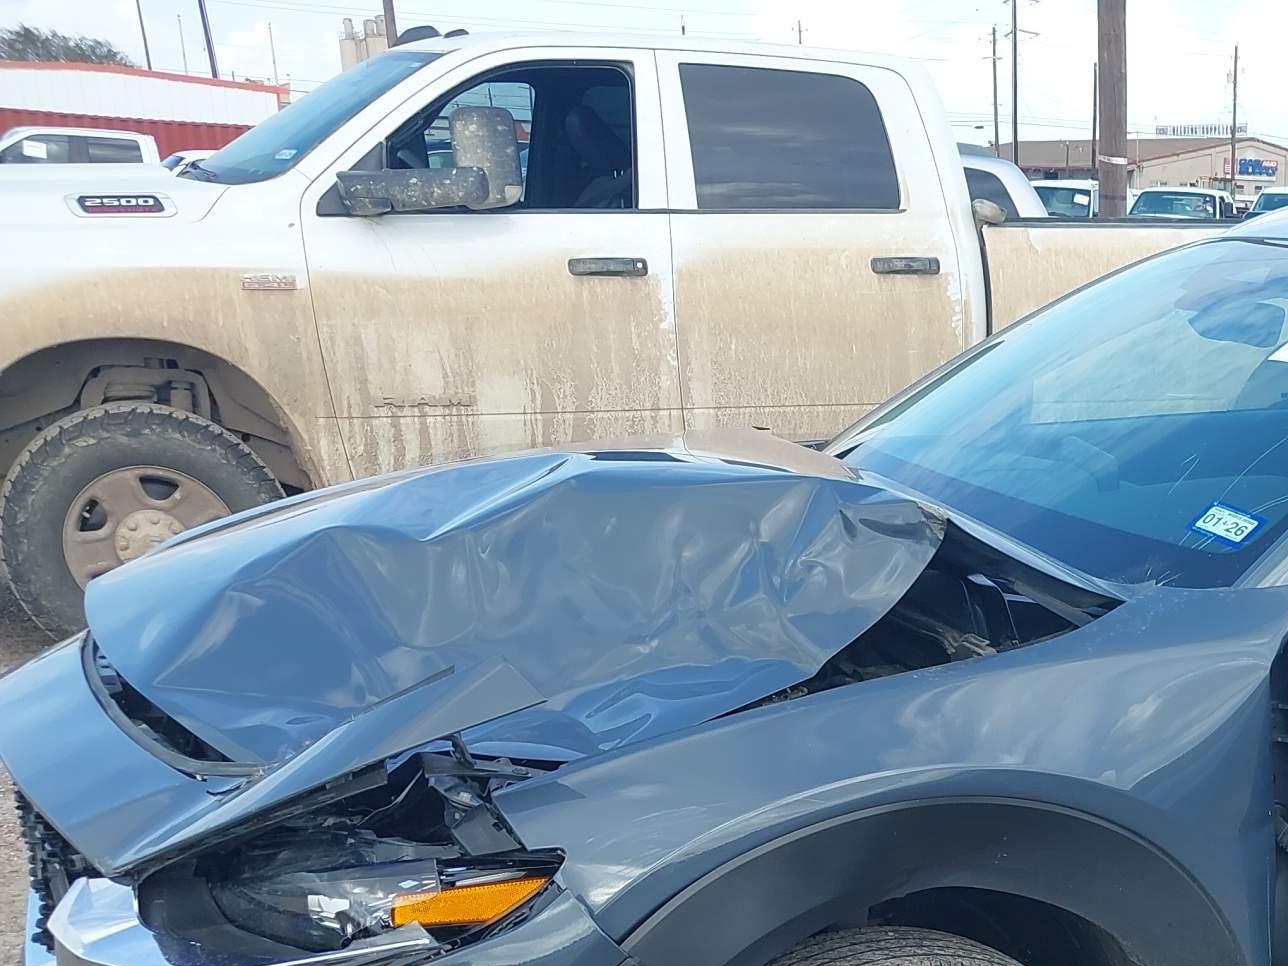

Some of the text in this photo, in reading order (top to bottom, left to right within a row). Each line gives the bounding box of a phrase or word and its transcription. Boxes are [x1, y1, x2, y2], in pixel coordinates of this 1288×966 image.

[84, 198, 155, 206] 2500
[1202, 513, 1223, 527] 01
[1224, 521, 1249, 537] 26
